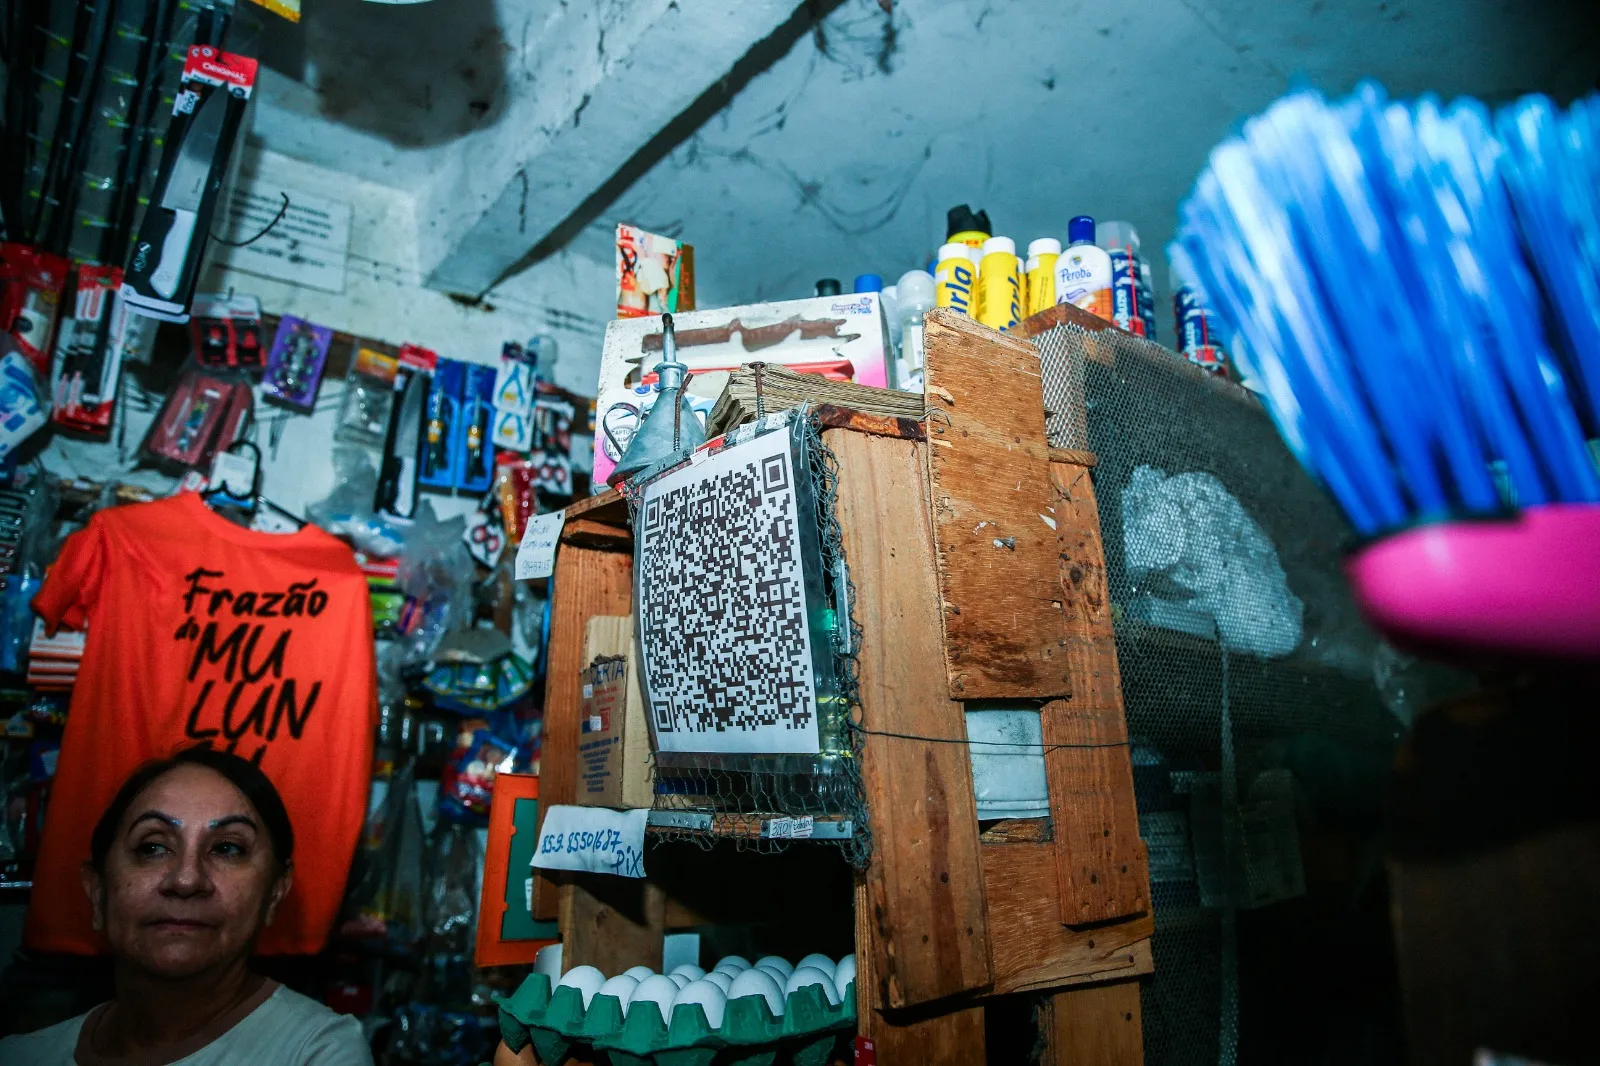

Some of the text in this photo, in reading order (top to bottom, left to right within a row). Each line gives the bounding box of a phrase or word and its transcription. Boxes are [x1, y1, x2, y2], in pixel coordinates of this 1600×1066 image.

[1058, 268, 1092, 283] Peroba
[183, 567, 328, 618] Frazão
[187, 621, 292, 684] MU
[185, 678, 322, 742] LUN
